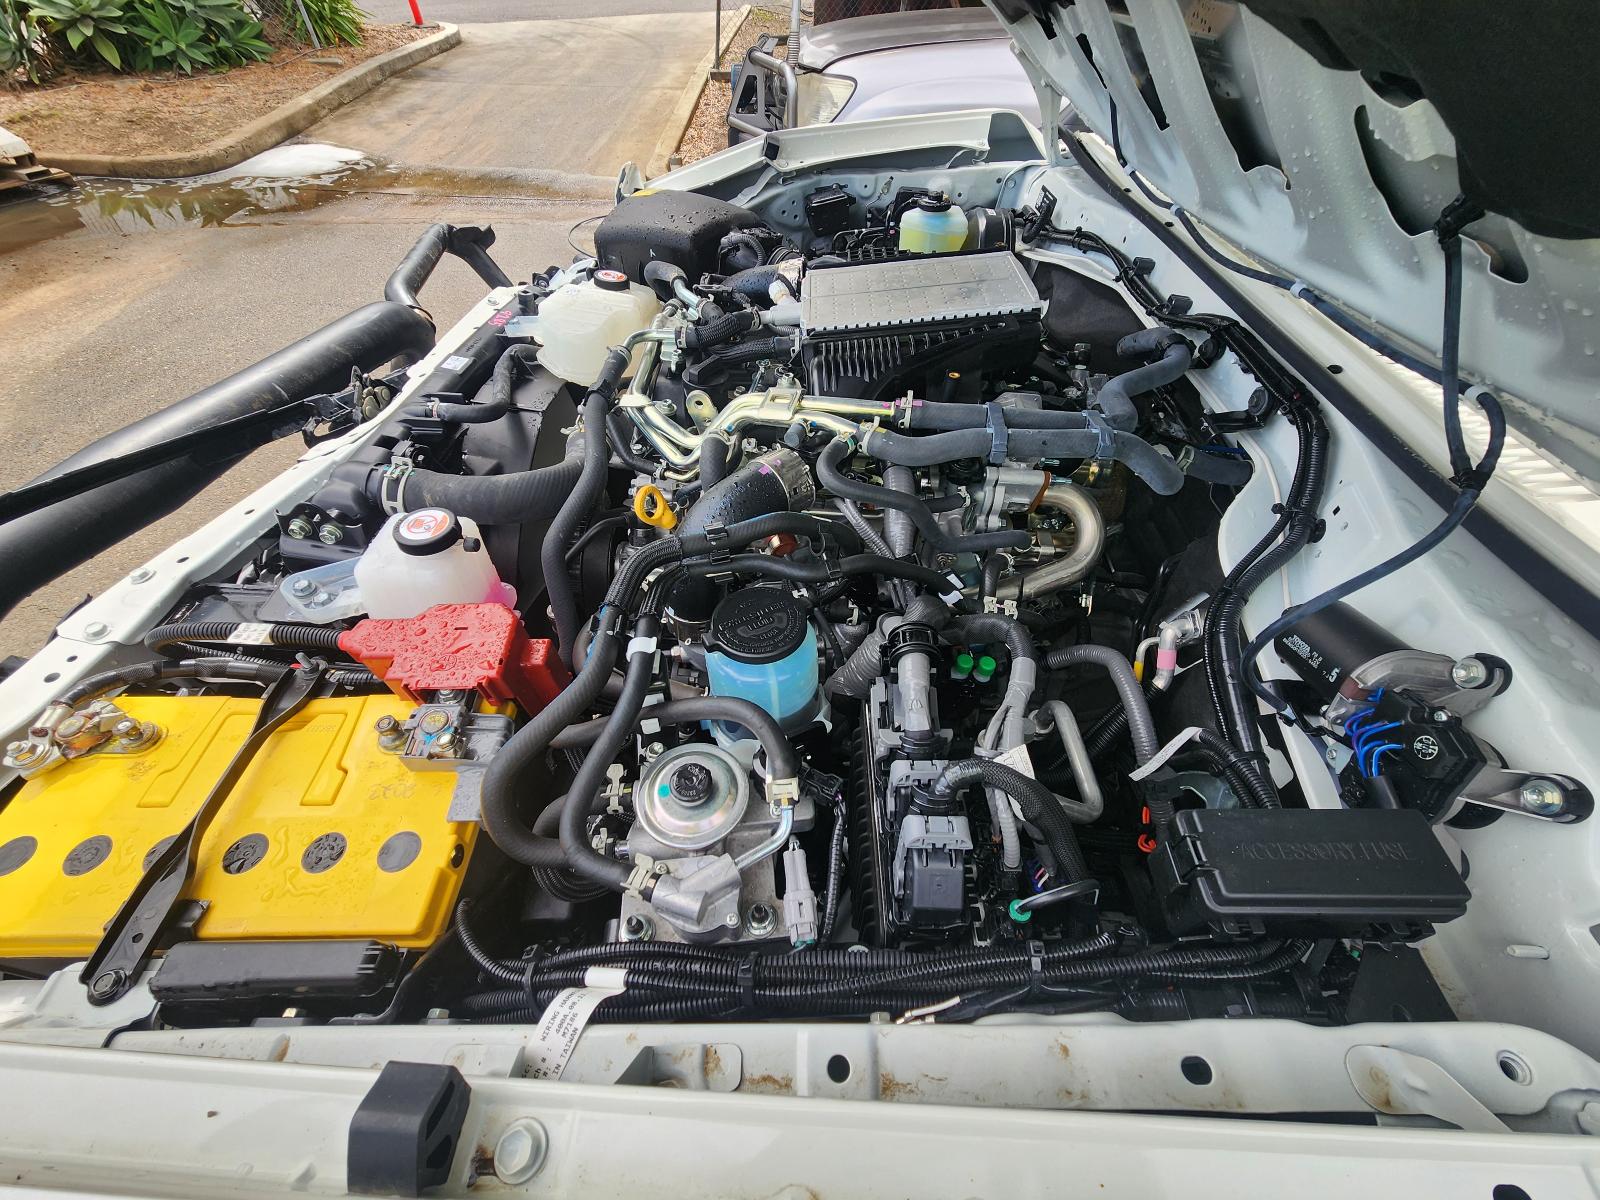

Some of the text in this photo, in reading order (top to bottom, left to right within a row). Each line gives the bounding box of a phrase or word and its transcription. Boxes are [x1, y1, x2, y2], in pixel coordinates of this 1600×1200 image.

[1292, 634, 1311, 653] TOYOTA
[1329, 667, 1341, 683] 5
[540, 1010, 560, 1042] WIRING
[552, 1026, 579, 1075] IN TAIWAN
